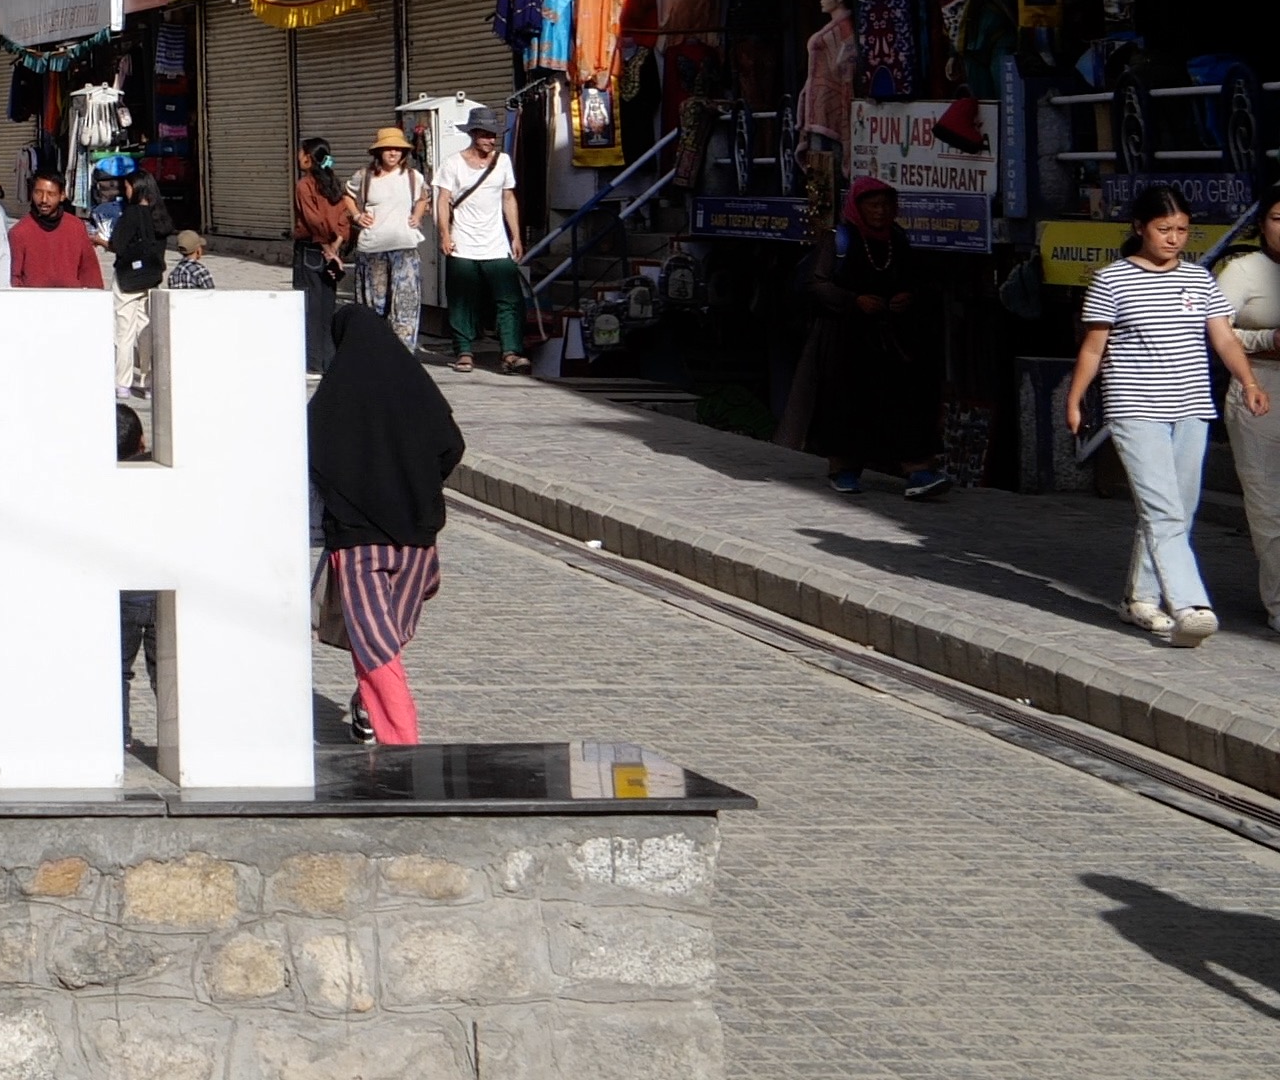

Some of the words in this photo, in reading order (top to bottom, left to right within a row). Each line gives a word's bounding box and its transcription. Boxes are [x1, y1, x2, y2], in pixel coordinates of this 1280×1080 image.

[1005, 61, 1016, 146] TREKKERS
[900, 163, 988, 193] RESTAURANT
[1006, 159, 1017, 210] POINT
[1105, 179, 1130, 202] THE
[1206, 178, 1246, 204] GEAR
[1051, 245, 1102, 262] AMULET
